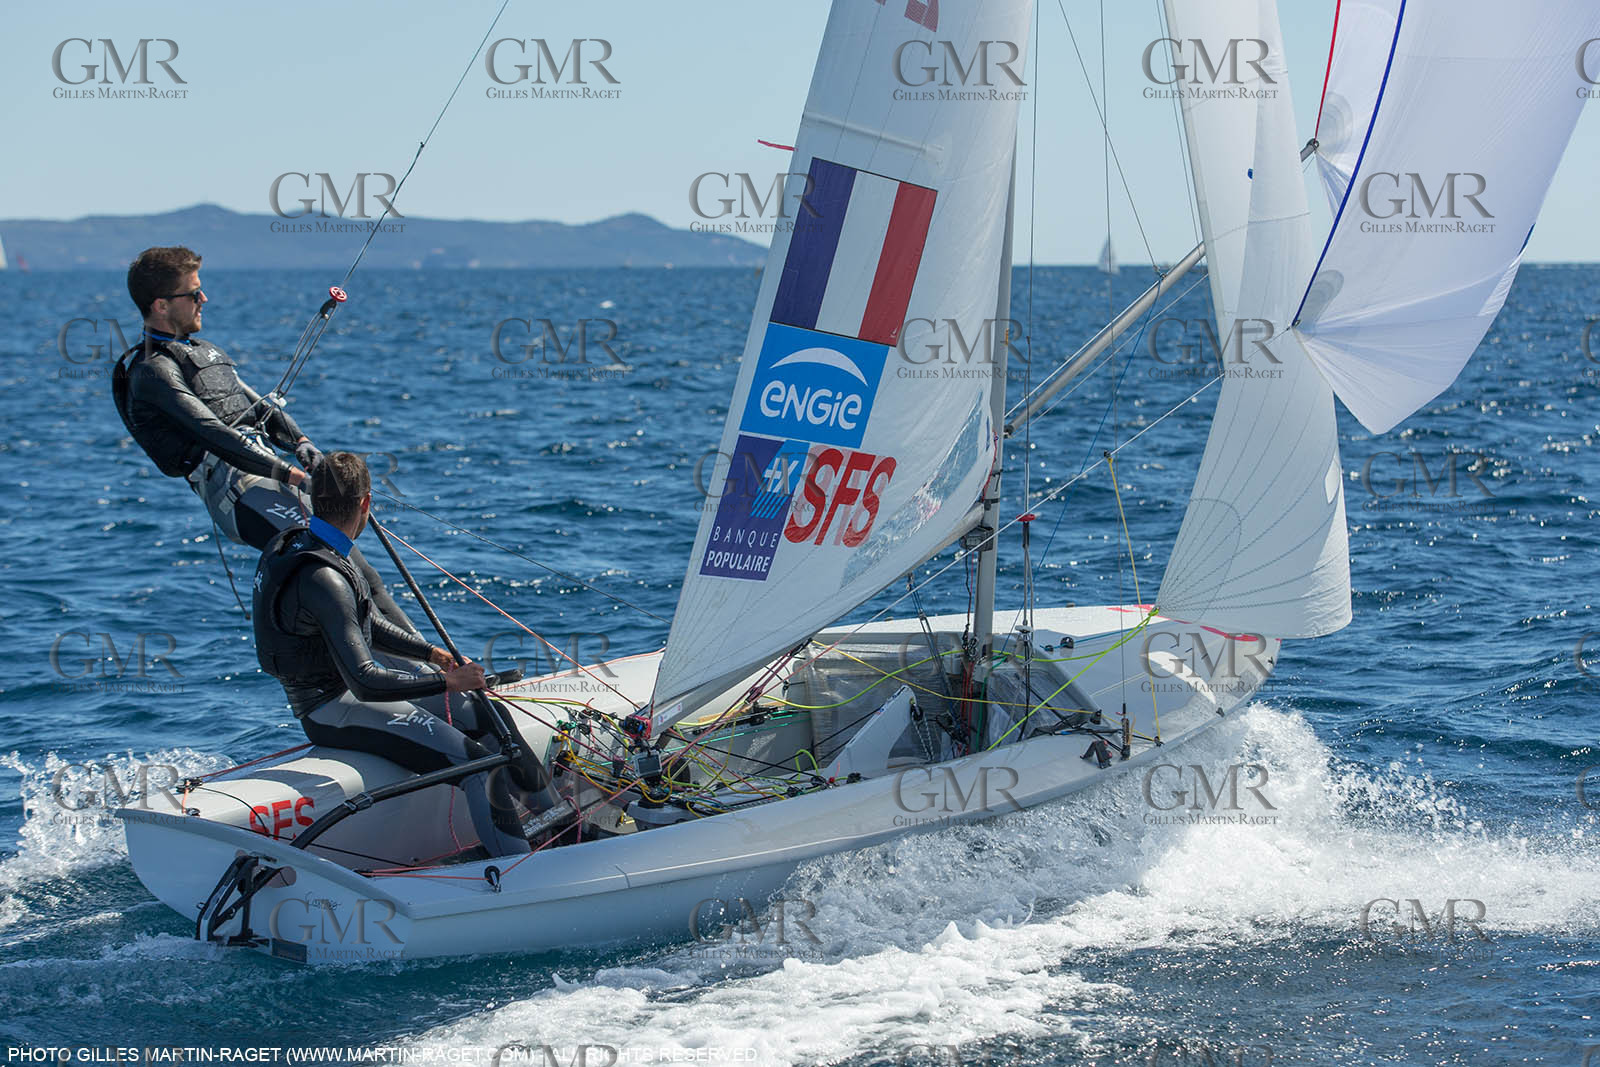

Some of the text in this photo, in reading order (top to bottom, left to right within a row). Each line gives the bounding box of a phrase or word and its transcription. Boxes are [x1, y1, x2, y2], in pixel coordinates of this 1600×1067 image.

[784, 445, 897, 548] SFS
[713, 526, 779, 548] BANQUE
[706, 550, 771, 572] POPULAIRE
